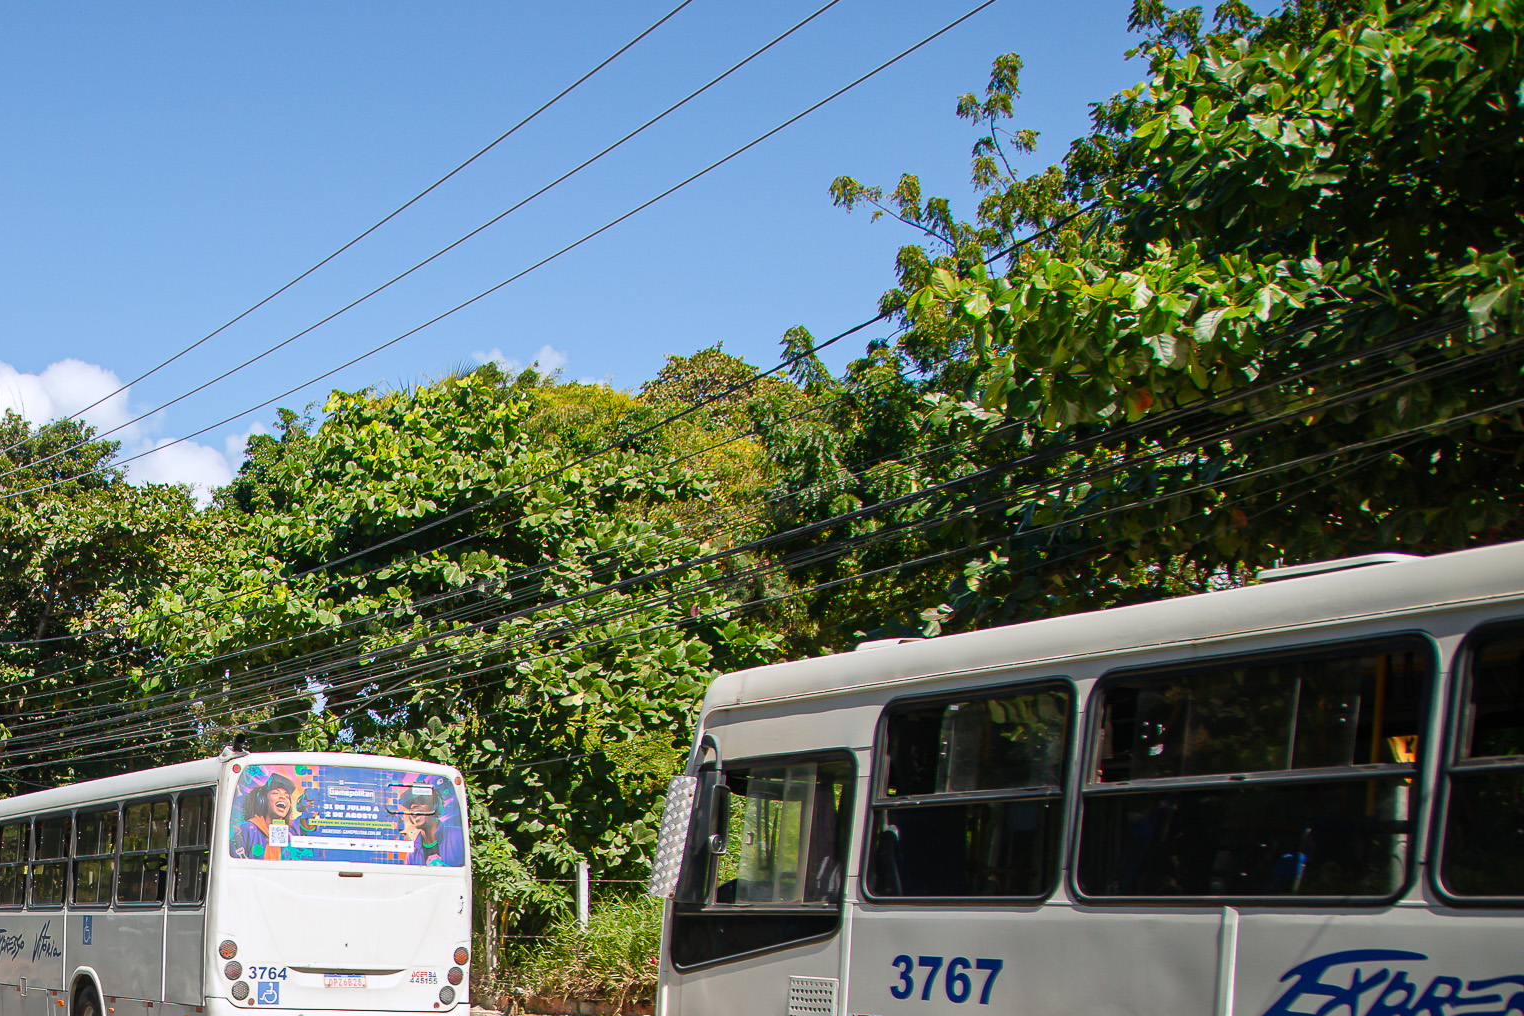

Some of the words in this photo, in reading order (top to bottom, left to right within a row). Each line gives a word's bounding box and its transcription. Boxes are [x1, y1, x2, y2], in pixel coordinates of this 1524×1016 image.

[347, 804, 372, 812] JULHO
[345, 812, 378, 820] AGOSTO
[249, 966, 287, 980] 3764
[409, 977, 438, 985] 445155
[889, 954, 1004, 1005] 3767
